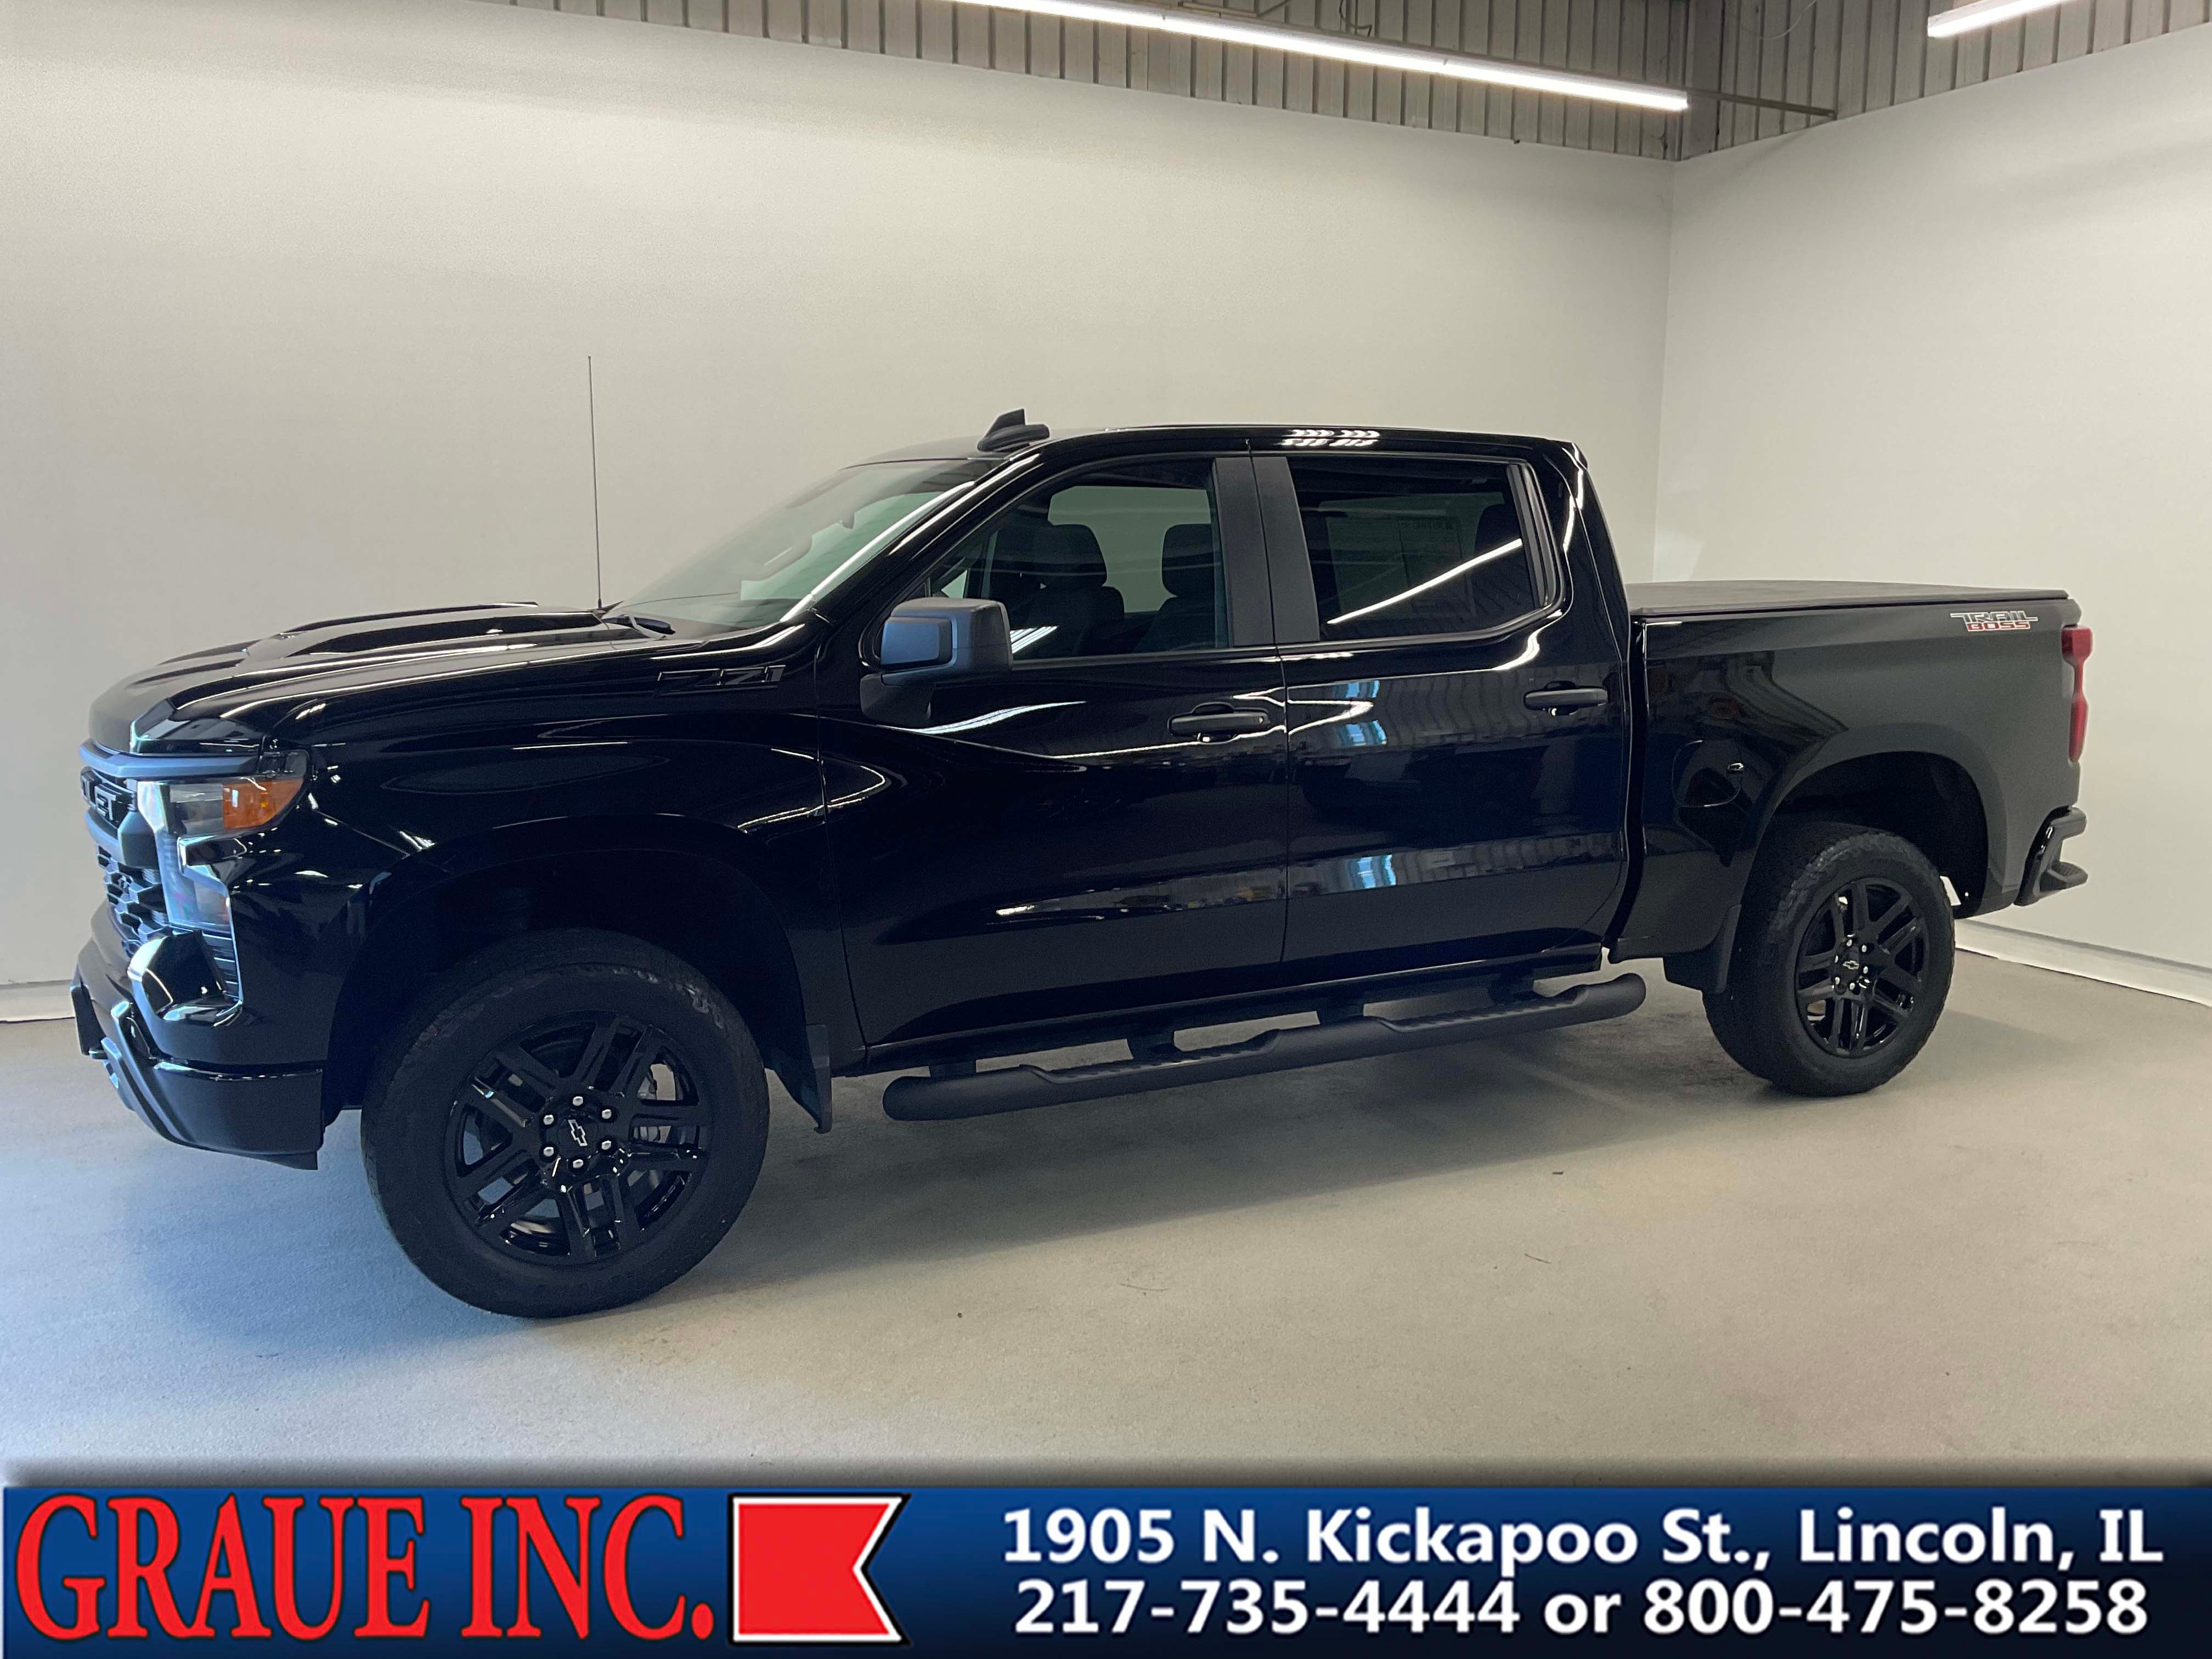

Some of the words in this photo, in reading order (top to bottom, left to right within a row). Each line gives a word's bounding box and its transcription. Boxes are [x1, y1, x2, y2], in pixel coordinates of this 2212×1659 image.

[1950, 610, 2039, 623] TRAIL
[1965, 620, 2031, 631] BOSS
[654, 664, 787, 698] Z71
